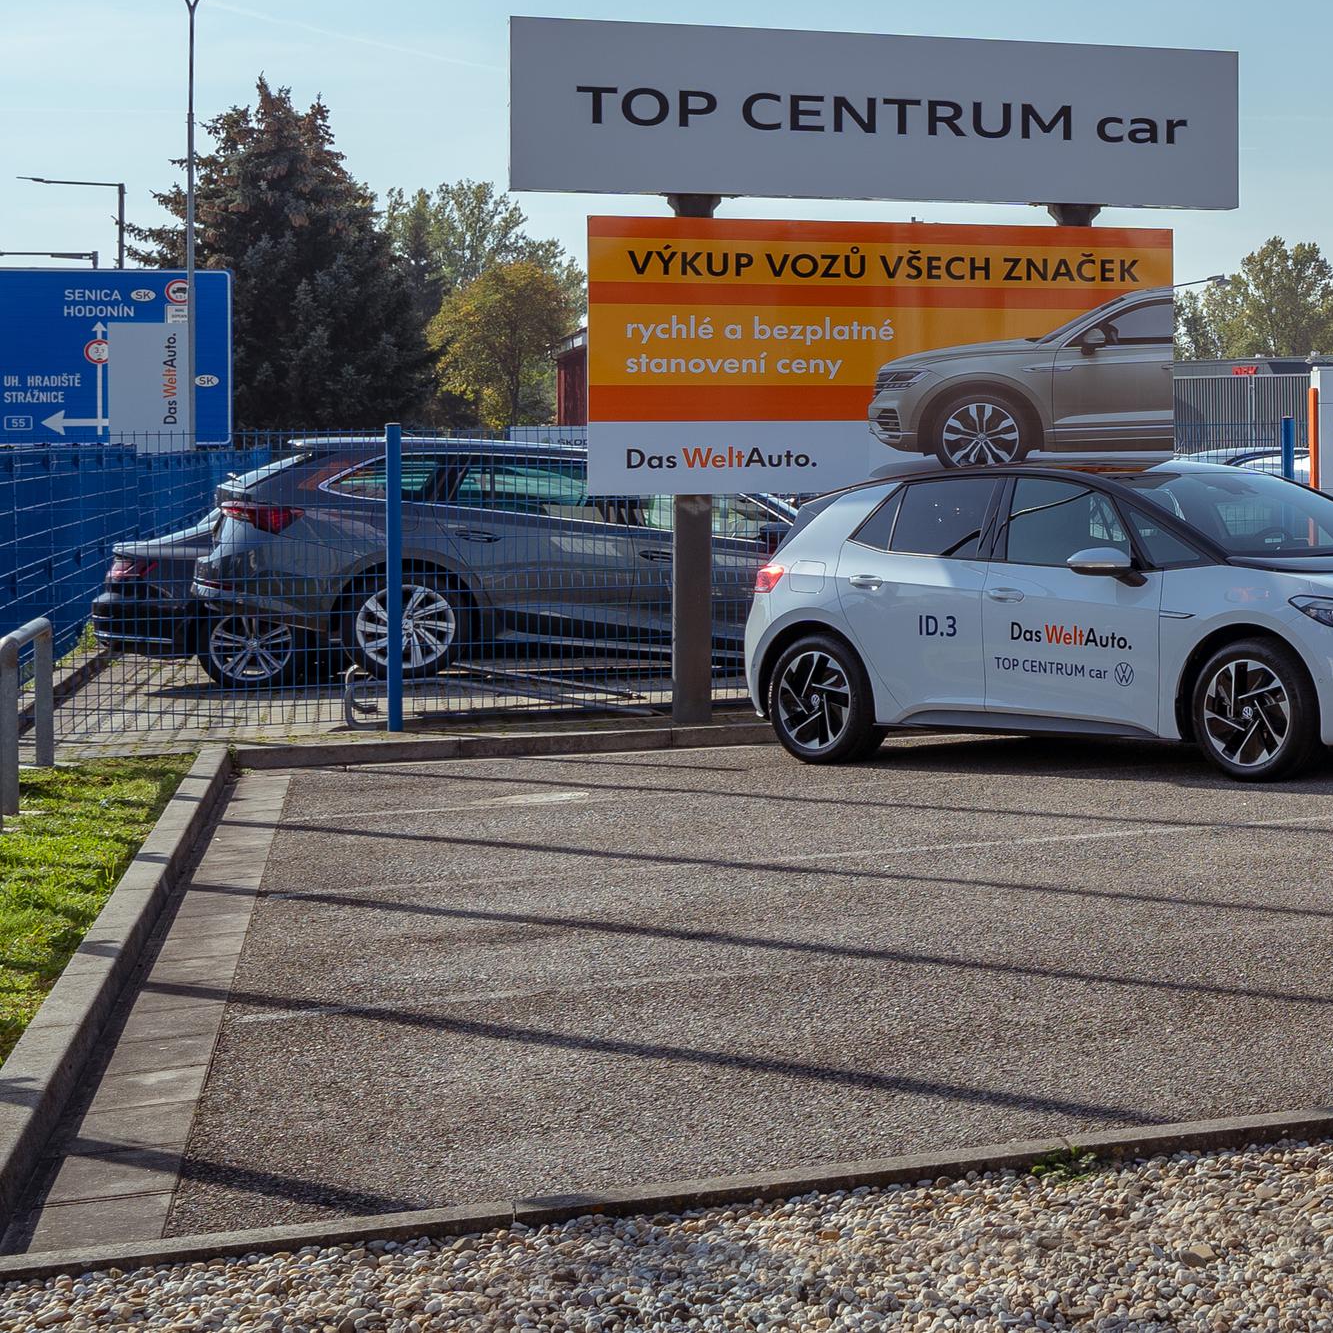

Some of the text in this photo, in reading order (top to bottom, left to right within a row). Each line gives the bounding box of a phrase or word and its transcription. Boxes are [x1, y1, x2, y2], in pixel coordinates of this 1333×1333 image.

[576, 85, 1188, 145] TOP CENTRUM car
[627, 244, 1140, 283] VÝKUP VOZŮ VŠECH ZNAČEK
[64, 289, 152, 301] SENICA SK
[63, 303, 135, 317] HODONÍN
[626, 315, 895, 346] rychlé a bezplatné
[625, 352, 844, 380] stanovení ceny
[4, 373, 82, 387] UH. HRADIŠTĚ
[162, 332, 177, 425] Das WeltAuto.
[198, 377, 215, 385] SK
[4, 389, 66, 403] STRÁŽNICE
[11, 419, 26, 428] 55
[626, 446, 818, 469] Das WeltAuto.
[918, 614, 958, 637] ID.3
[1010, 621, 1133, 650] Das WeltAuto.
[994, 656, 1109, 680] TOP CENTRUM car
